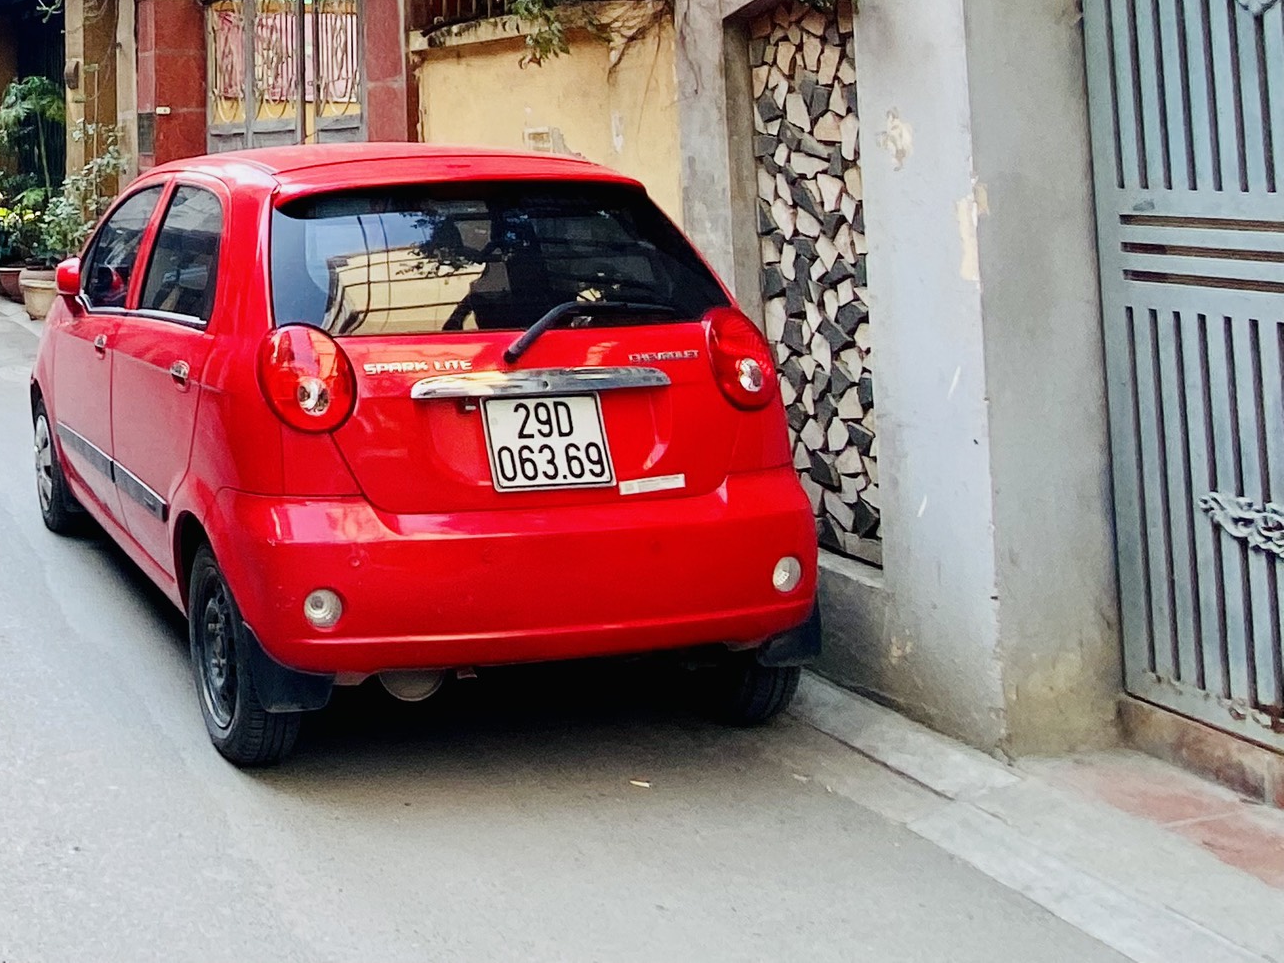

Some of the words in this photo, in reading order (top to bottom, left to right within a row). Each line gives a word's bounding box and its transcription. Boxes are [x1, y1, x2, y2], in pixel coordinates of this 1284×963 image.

[363, 361, 429, 376] SPARK
[433, 359, 473, 372] LITE
[628, 349, 699, 362] CHEVROLET
[513, 401, 574, 439] 29D
[497, 442, 606, 482] 063.69
